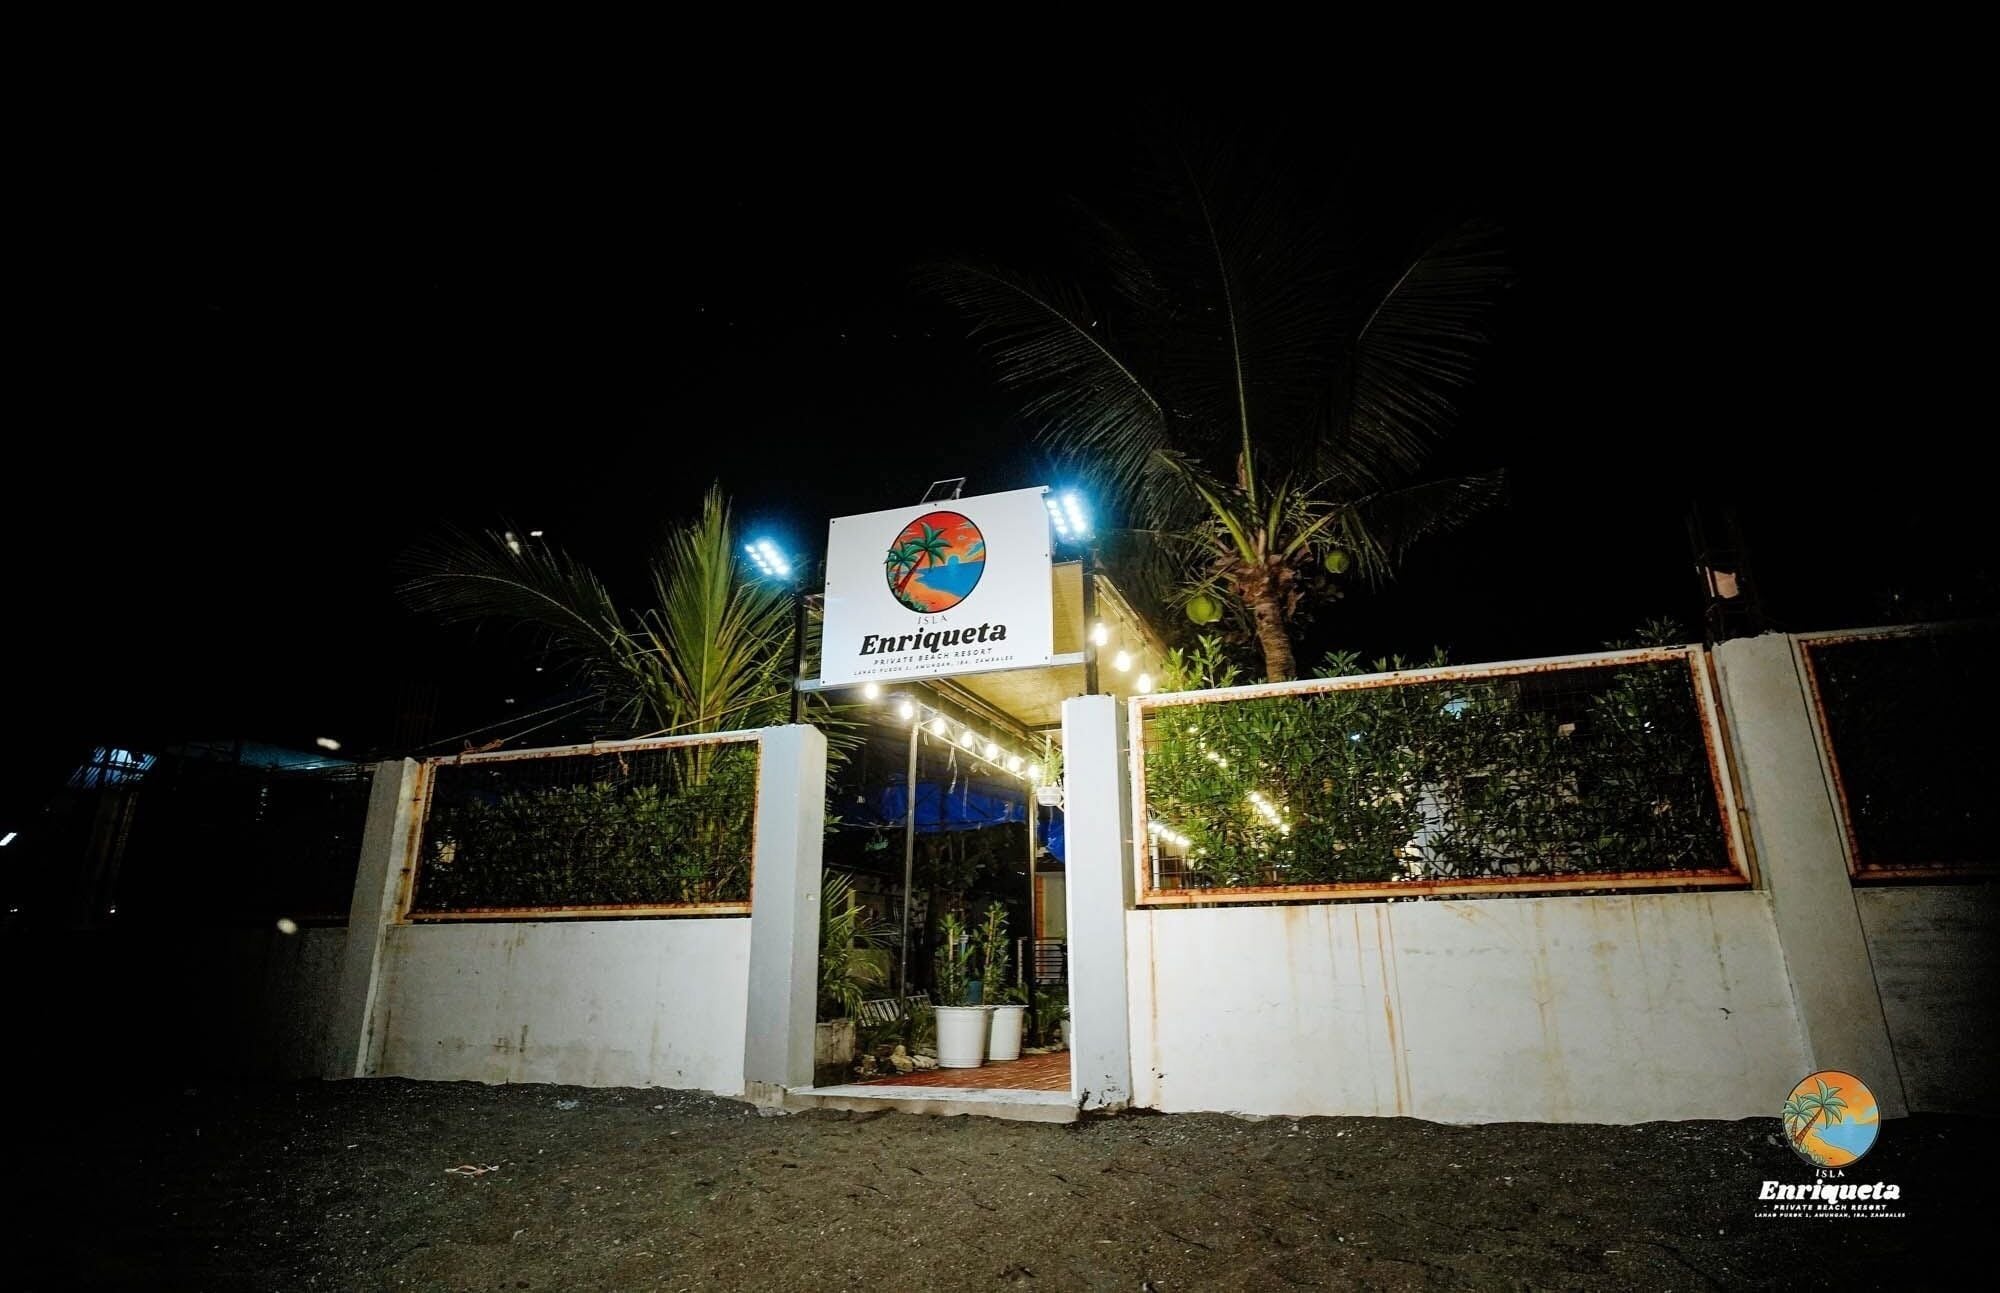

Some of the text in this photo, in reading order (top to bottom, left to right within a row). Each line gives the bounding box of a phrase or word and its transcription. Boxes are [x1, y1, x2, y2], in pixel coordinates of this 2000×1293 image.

[917, 615, 947, 625] ISLA
[859, 622, 1007, 655] Enriqueta
[874, 647, 993, 666] PRIVATE BEACH RESORT
